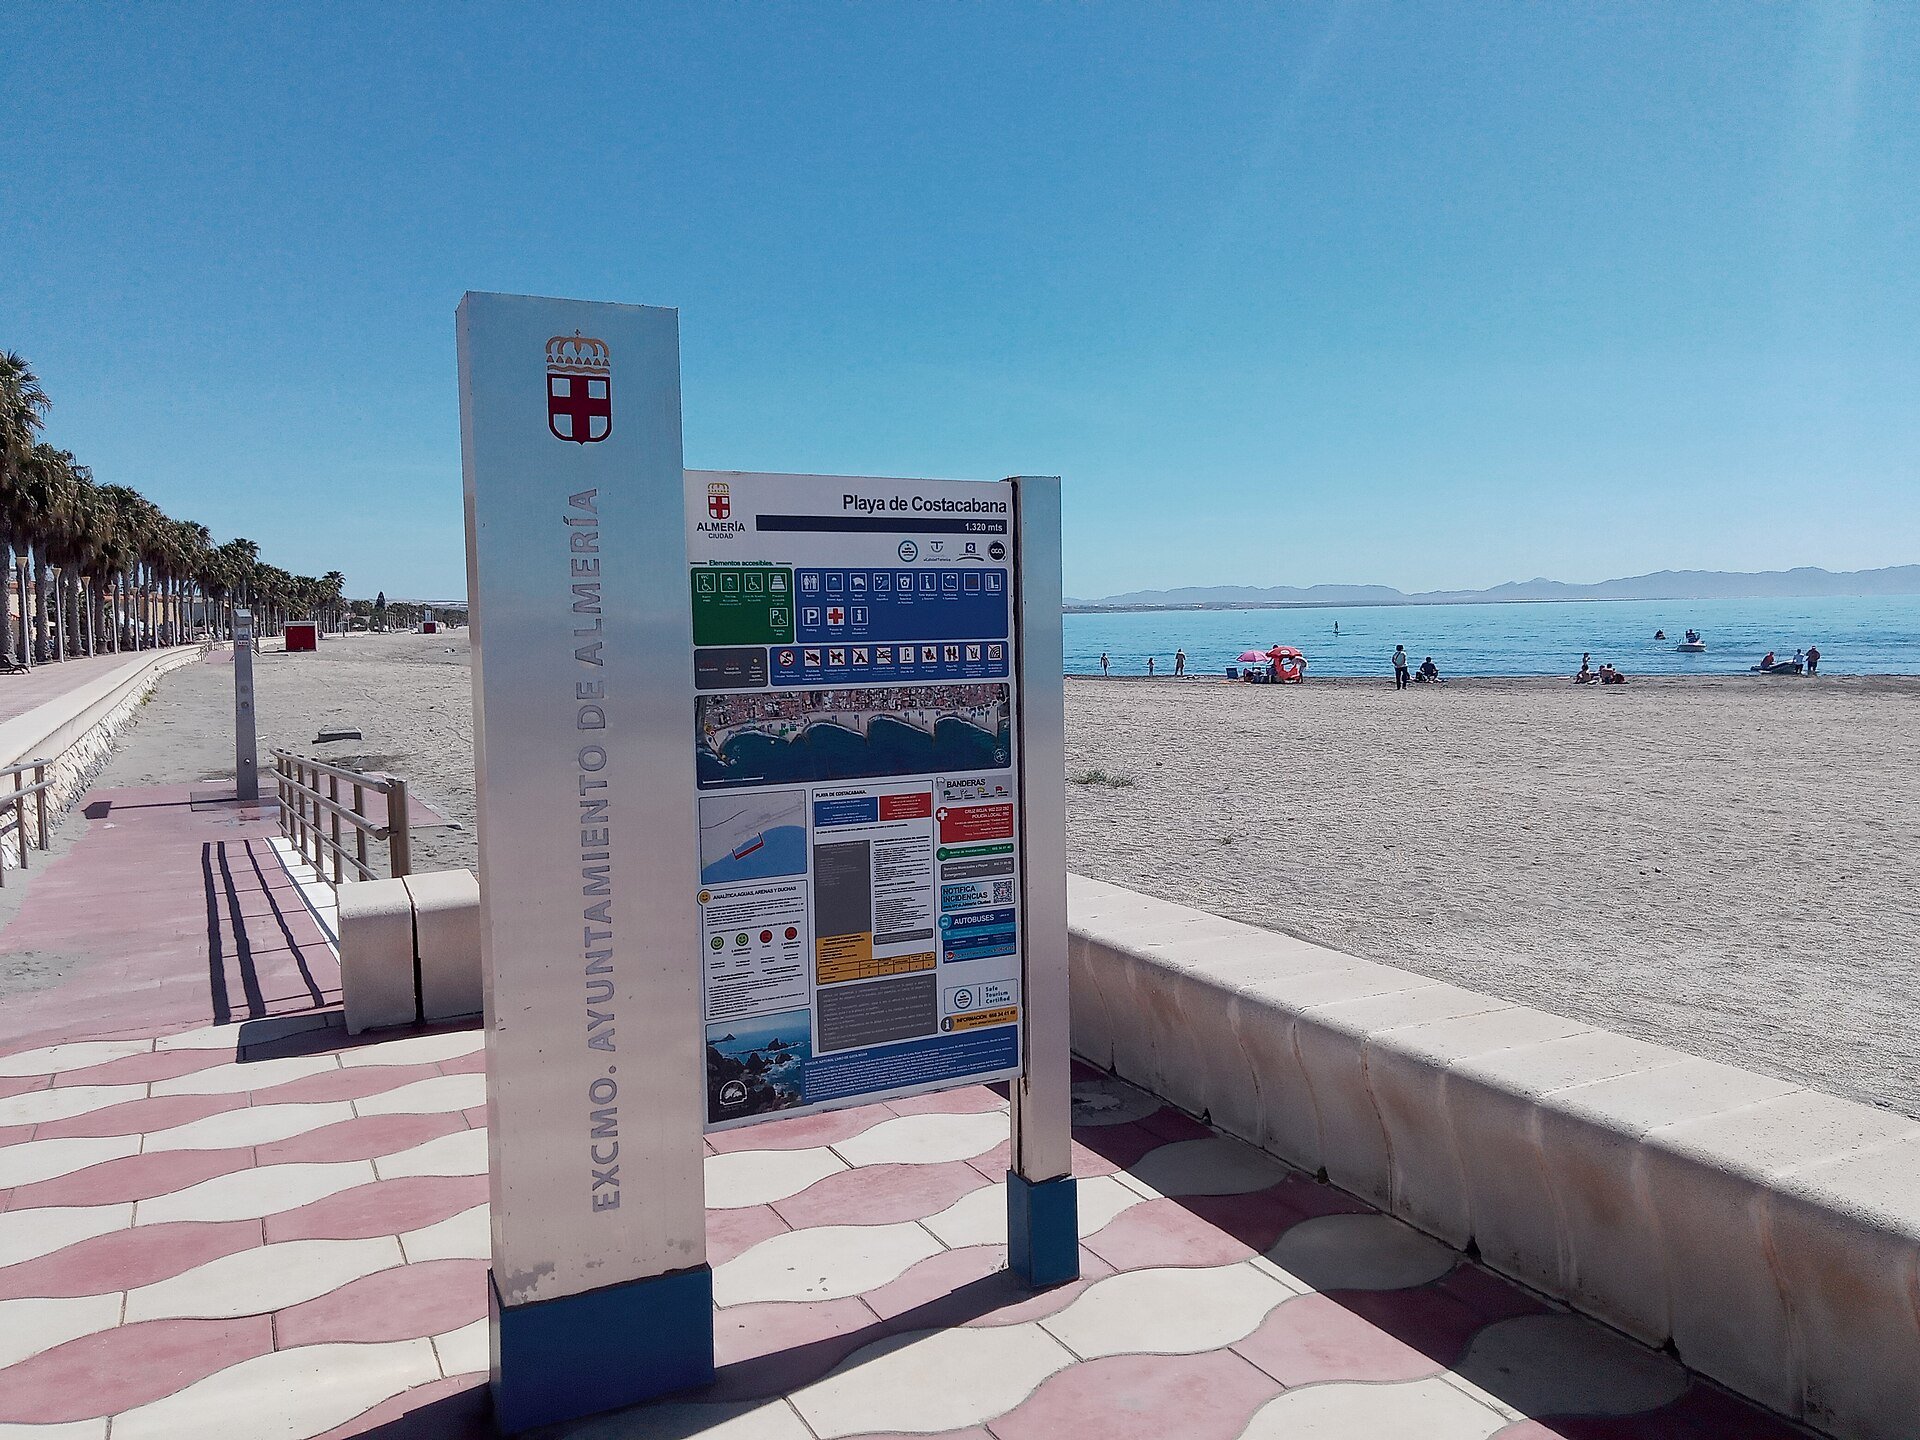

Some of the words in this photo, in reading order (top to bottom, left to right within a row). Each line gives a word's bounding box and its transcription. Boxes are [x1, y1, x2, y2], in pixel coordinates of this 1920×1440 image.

[843, 495, 886, 514] Playa
[889, 496, 908, 511] de
[911, 496, 1007, 513] Costacabana
[696, 521, 746, 532] ALMERÍA
[965, 522, 986, 531] 1.320
[987, 524, 1003, 532] mts
[563, 488, 605, 667] ALMERÍA
[575, 680, 607, 730] DE
[946, 779, 985, 788] BANDERAS
[942, 885, 976, 895] NOTIFICA
[578, 744, 617, 1053] AYUNTAMIENTO
[943, 891, 988, 902] INCIDENCIAS
[953, 913, 995, 926] AUTOBUSES
[985, 995, 1010, 1004] Certified
[589, 1065, 621, 1213] EXCMO.
